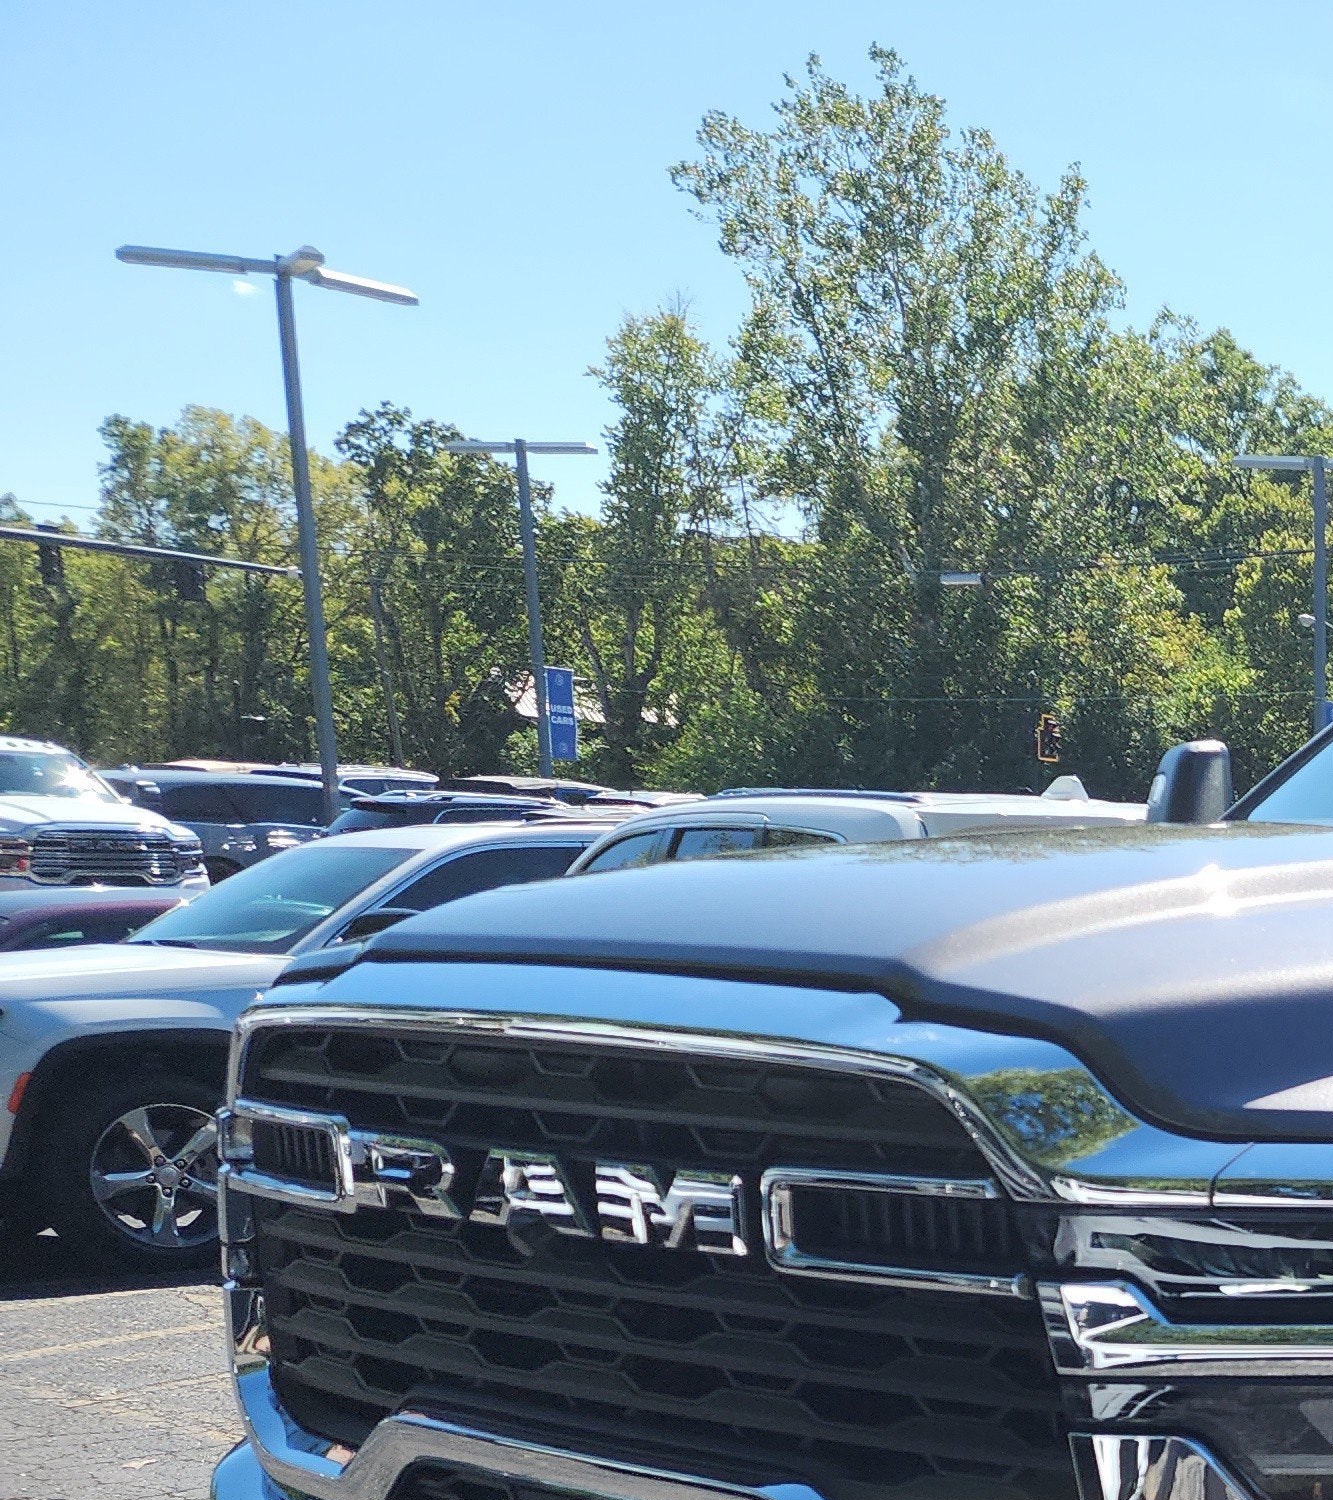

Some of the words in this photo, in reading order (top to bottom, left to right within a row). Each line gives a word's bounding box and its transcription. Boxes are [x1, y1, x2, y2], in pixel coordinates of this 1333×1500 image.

[551, 704, 573, 714] USED
[551, 716, 573, 725] CARS
[346, 1128, 749, 1257] RAM
